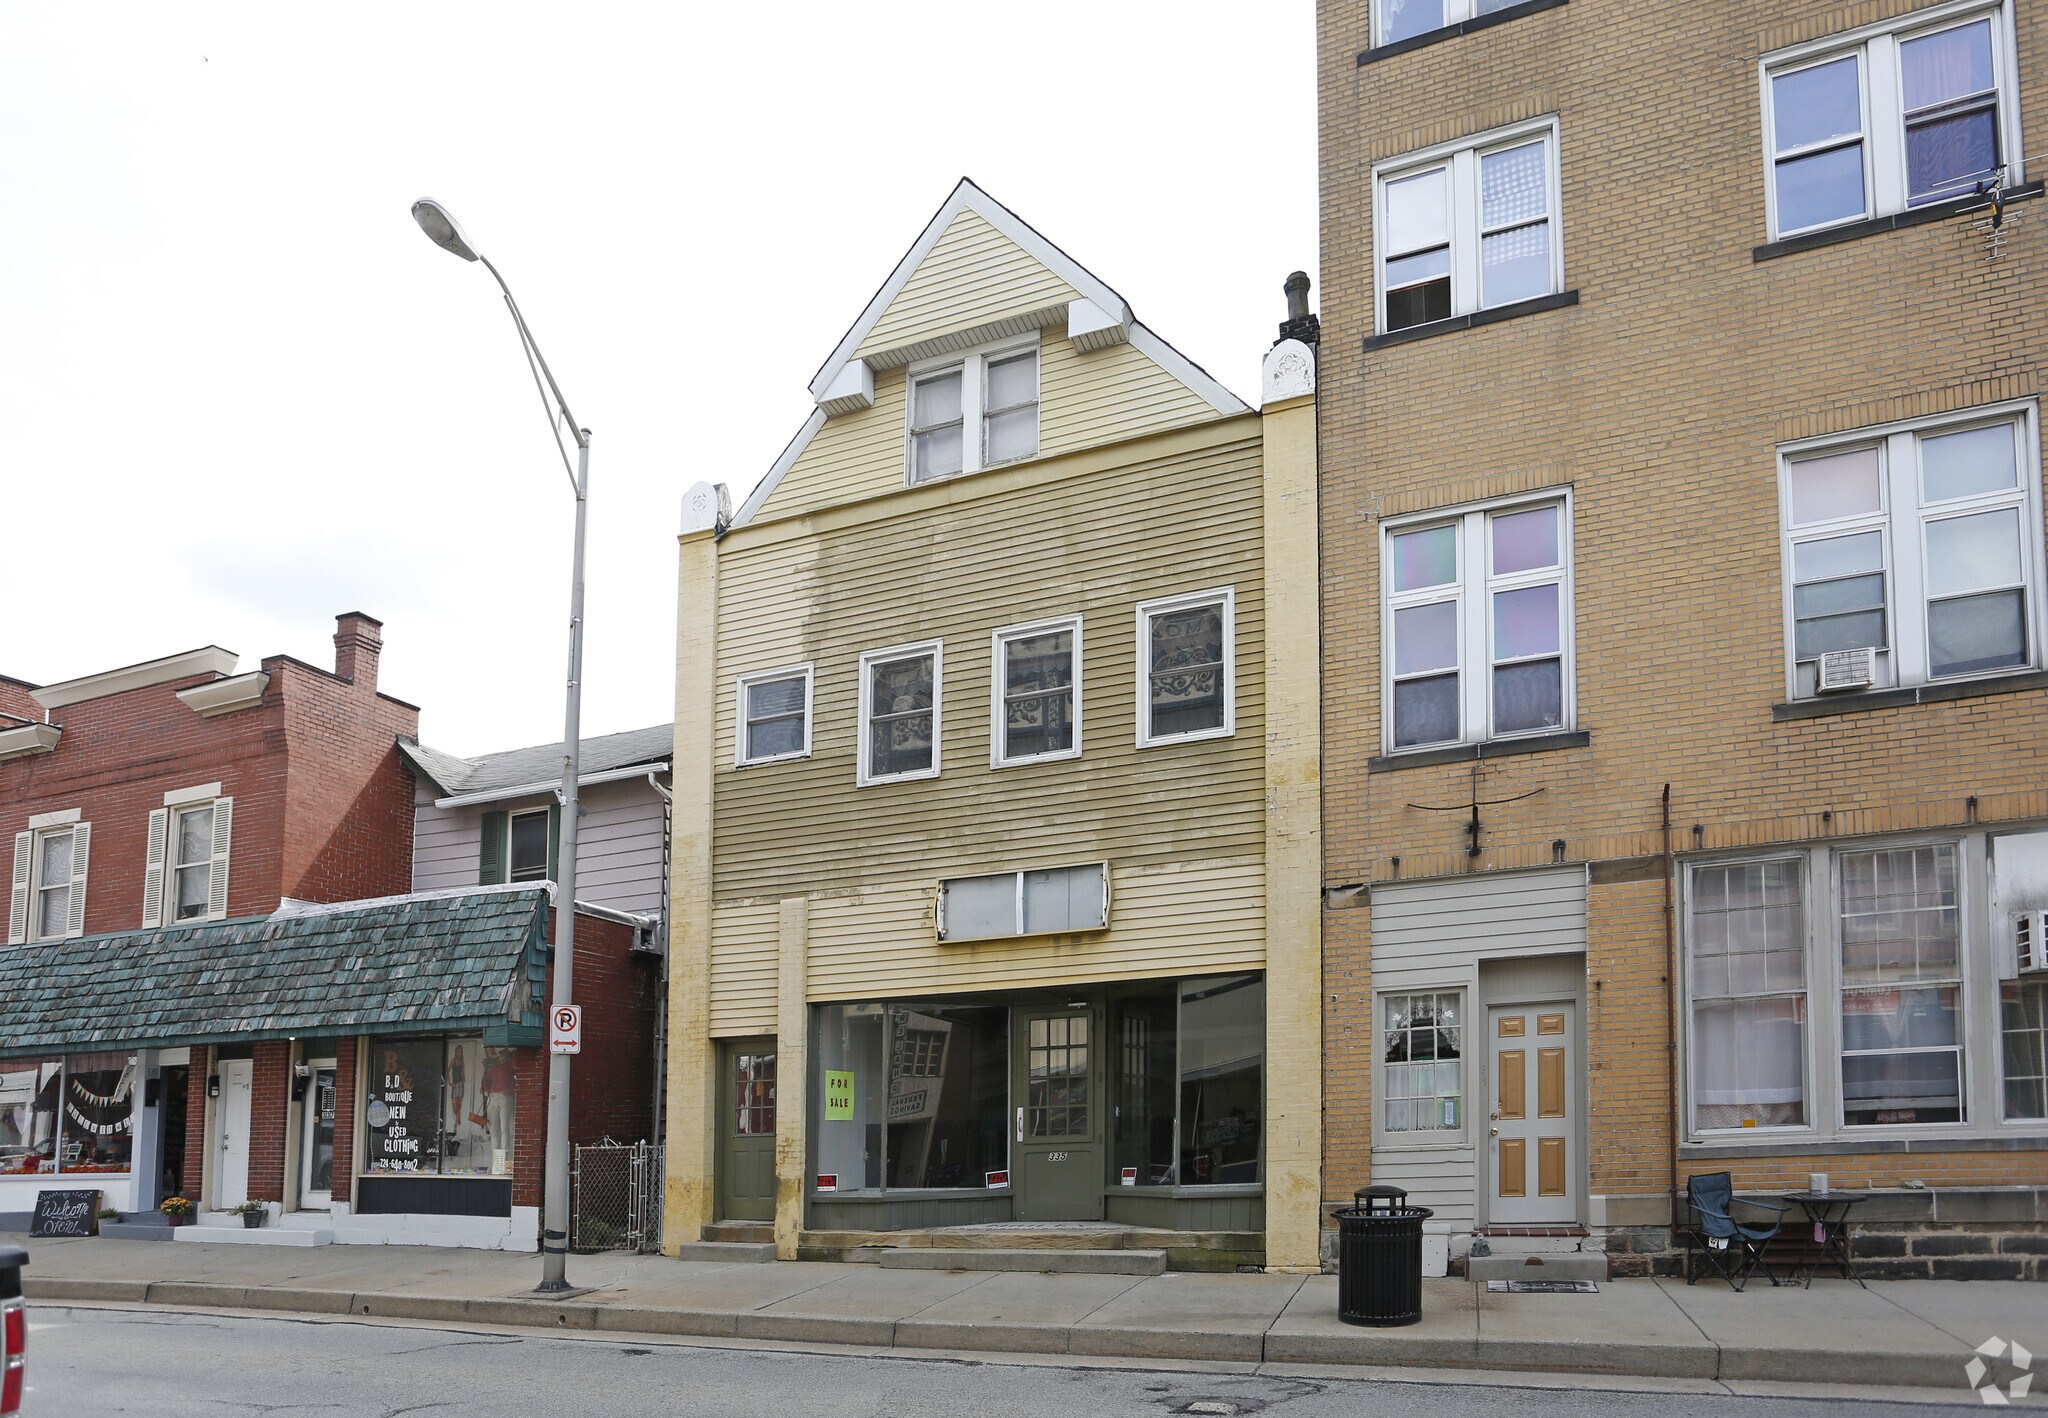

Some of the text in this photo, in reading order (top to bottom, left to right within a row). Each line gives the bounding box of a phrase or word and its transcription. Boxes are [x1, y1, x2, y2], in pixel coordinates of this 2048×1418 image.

[830, 1078, 848, 1089] FOR
[384, 1090, 413, 1104] BOUTIQUE
[830, 1097, 848, 1108] SALE
[389, 1106, 407, 1119] NEW
[389, 1126, 407, 1139] USED
[1048, 1152, 1068, 1161] 335
[42, 1200, 89, 1219] Welcome
